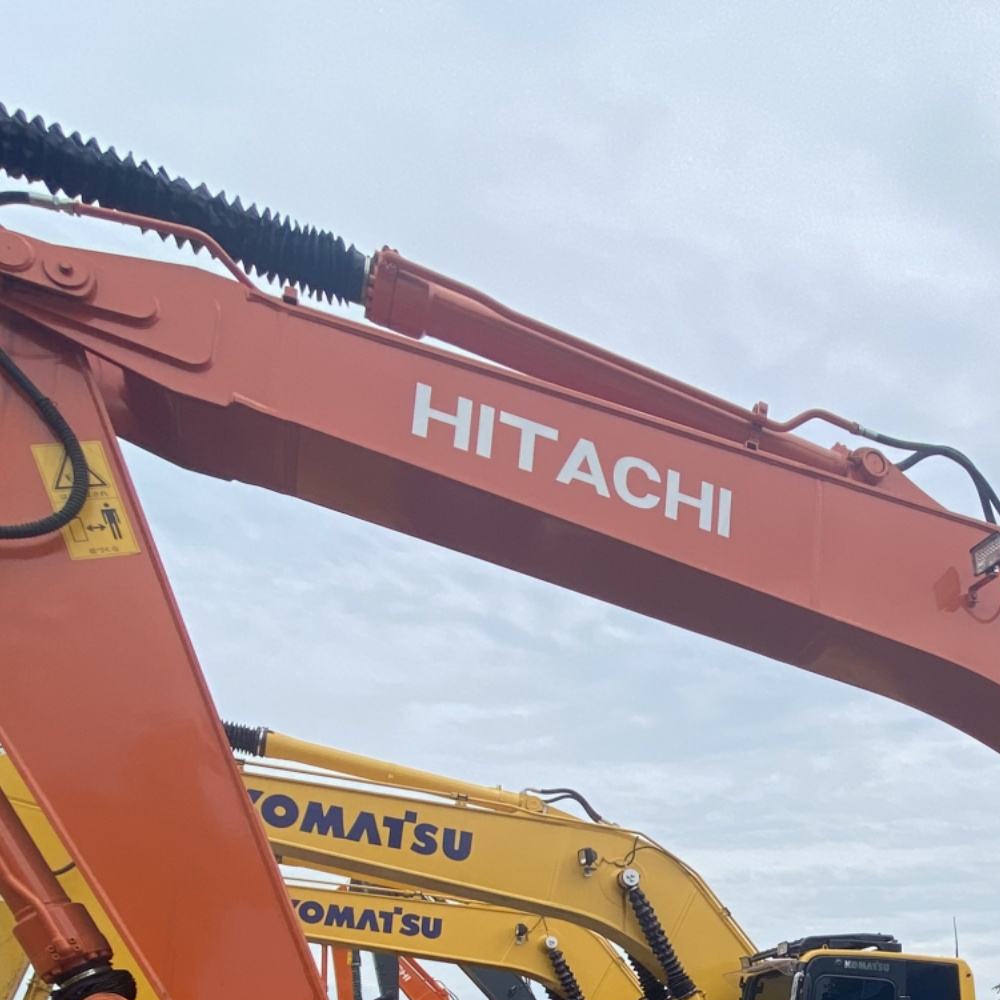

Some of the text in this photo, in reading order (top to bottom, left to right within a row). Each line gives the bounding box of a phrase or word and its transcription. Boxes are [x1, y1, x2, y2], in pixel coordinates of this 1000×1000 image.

[411, 382, 732, 538] HITACHI
[247, 789, 473, 862] OMATSU
[292, 900, 443, 940] OMATSU
[844, 959, 890, 972] KOMATSU
